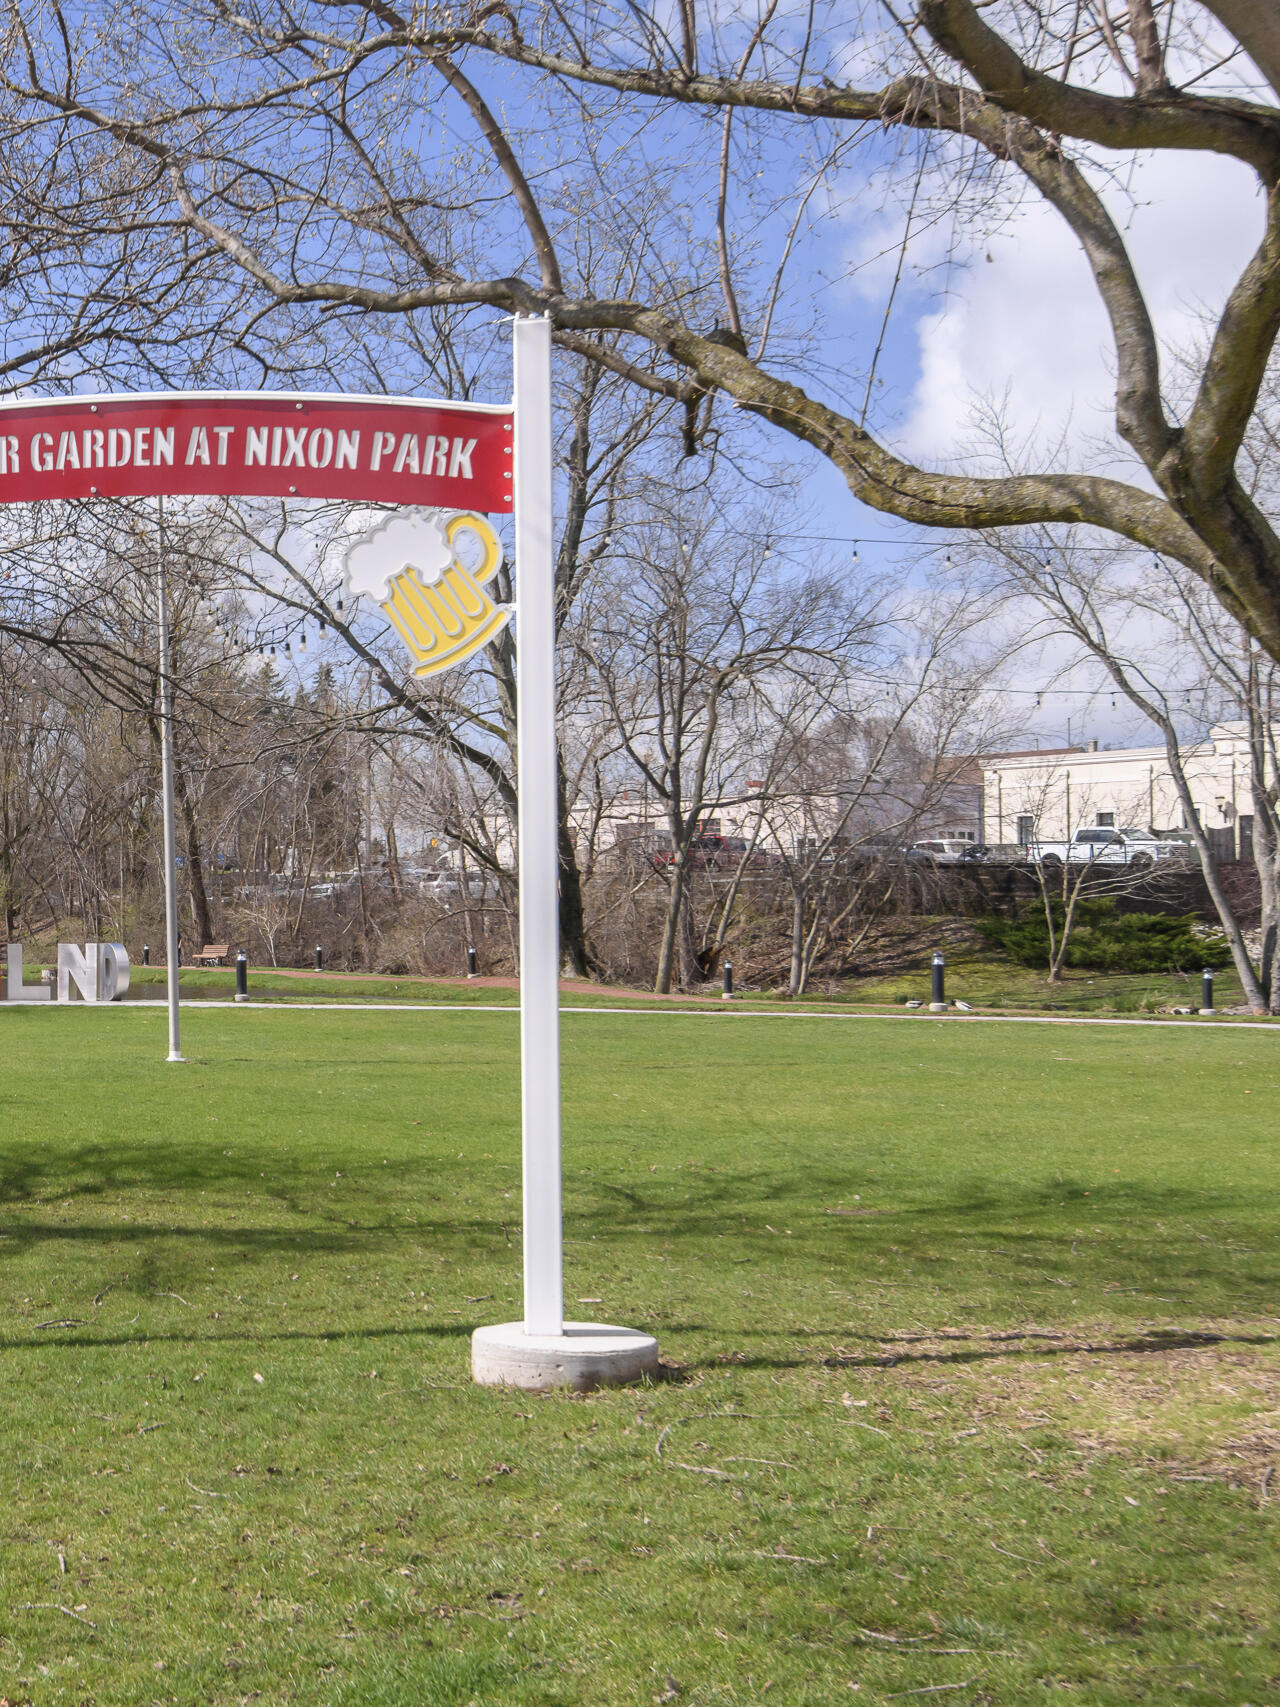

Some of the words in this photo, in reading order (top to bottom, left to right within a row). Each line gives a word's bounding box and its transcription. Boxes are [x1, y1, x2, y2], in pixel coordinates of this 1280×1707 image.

[31, 427, 175, 472] GARDEN
[185, 427, 235, 466] AT
[245, 427, 361, 469] NIXON
[370, 432, 478, 479] PARK
